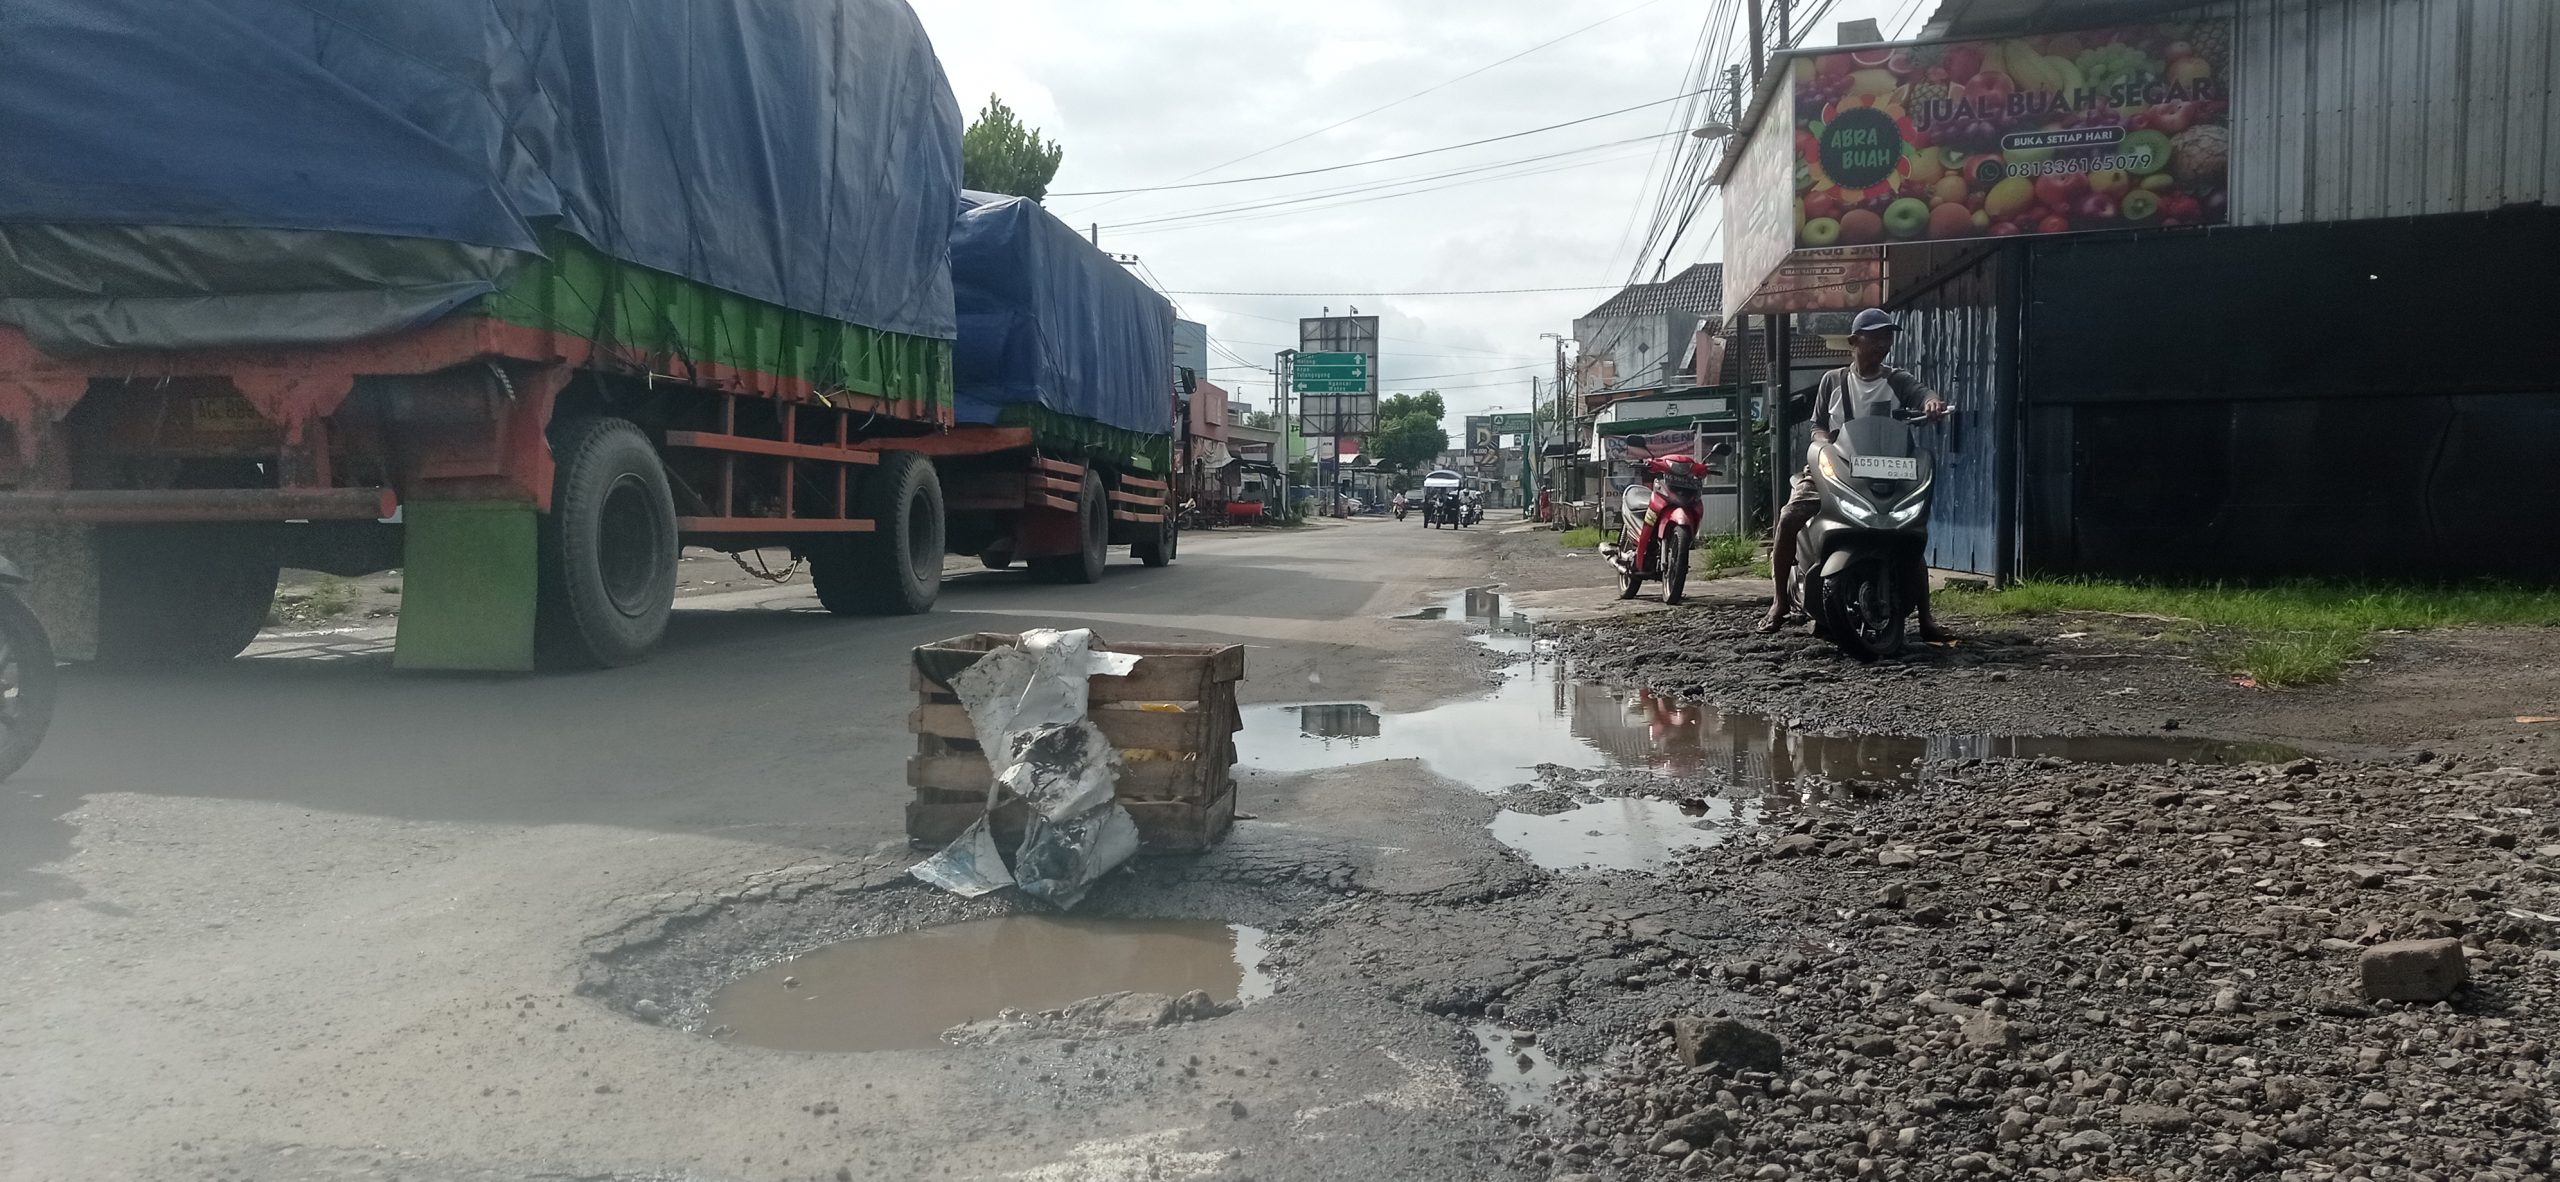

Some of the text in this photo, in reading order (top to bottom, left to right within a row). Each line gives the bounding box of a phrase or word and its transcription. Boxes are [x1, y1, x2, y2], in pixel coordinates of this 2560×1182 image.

[1917, 77, 2212, 132] JUAL BUAH SEGAR
[1831, 128, 1877, 149] ABRA
[2013, 130, 2113, 147] BUKA SETIAP HARI
[1842, 149, 1891, 170] BUAH
[2006, 154, 2152, 178] 081336165079
